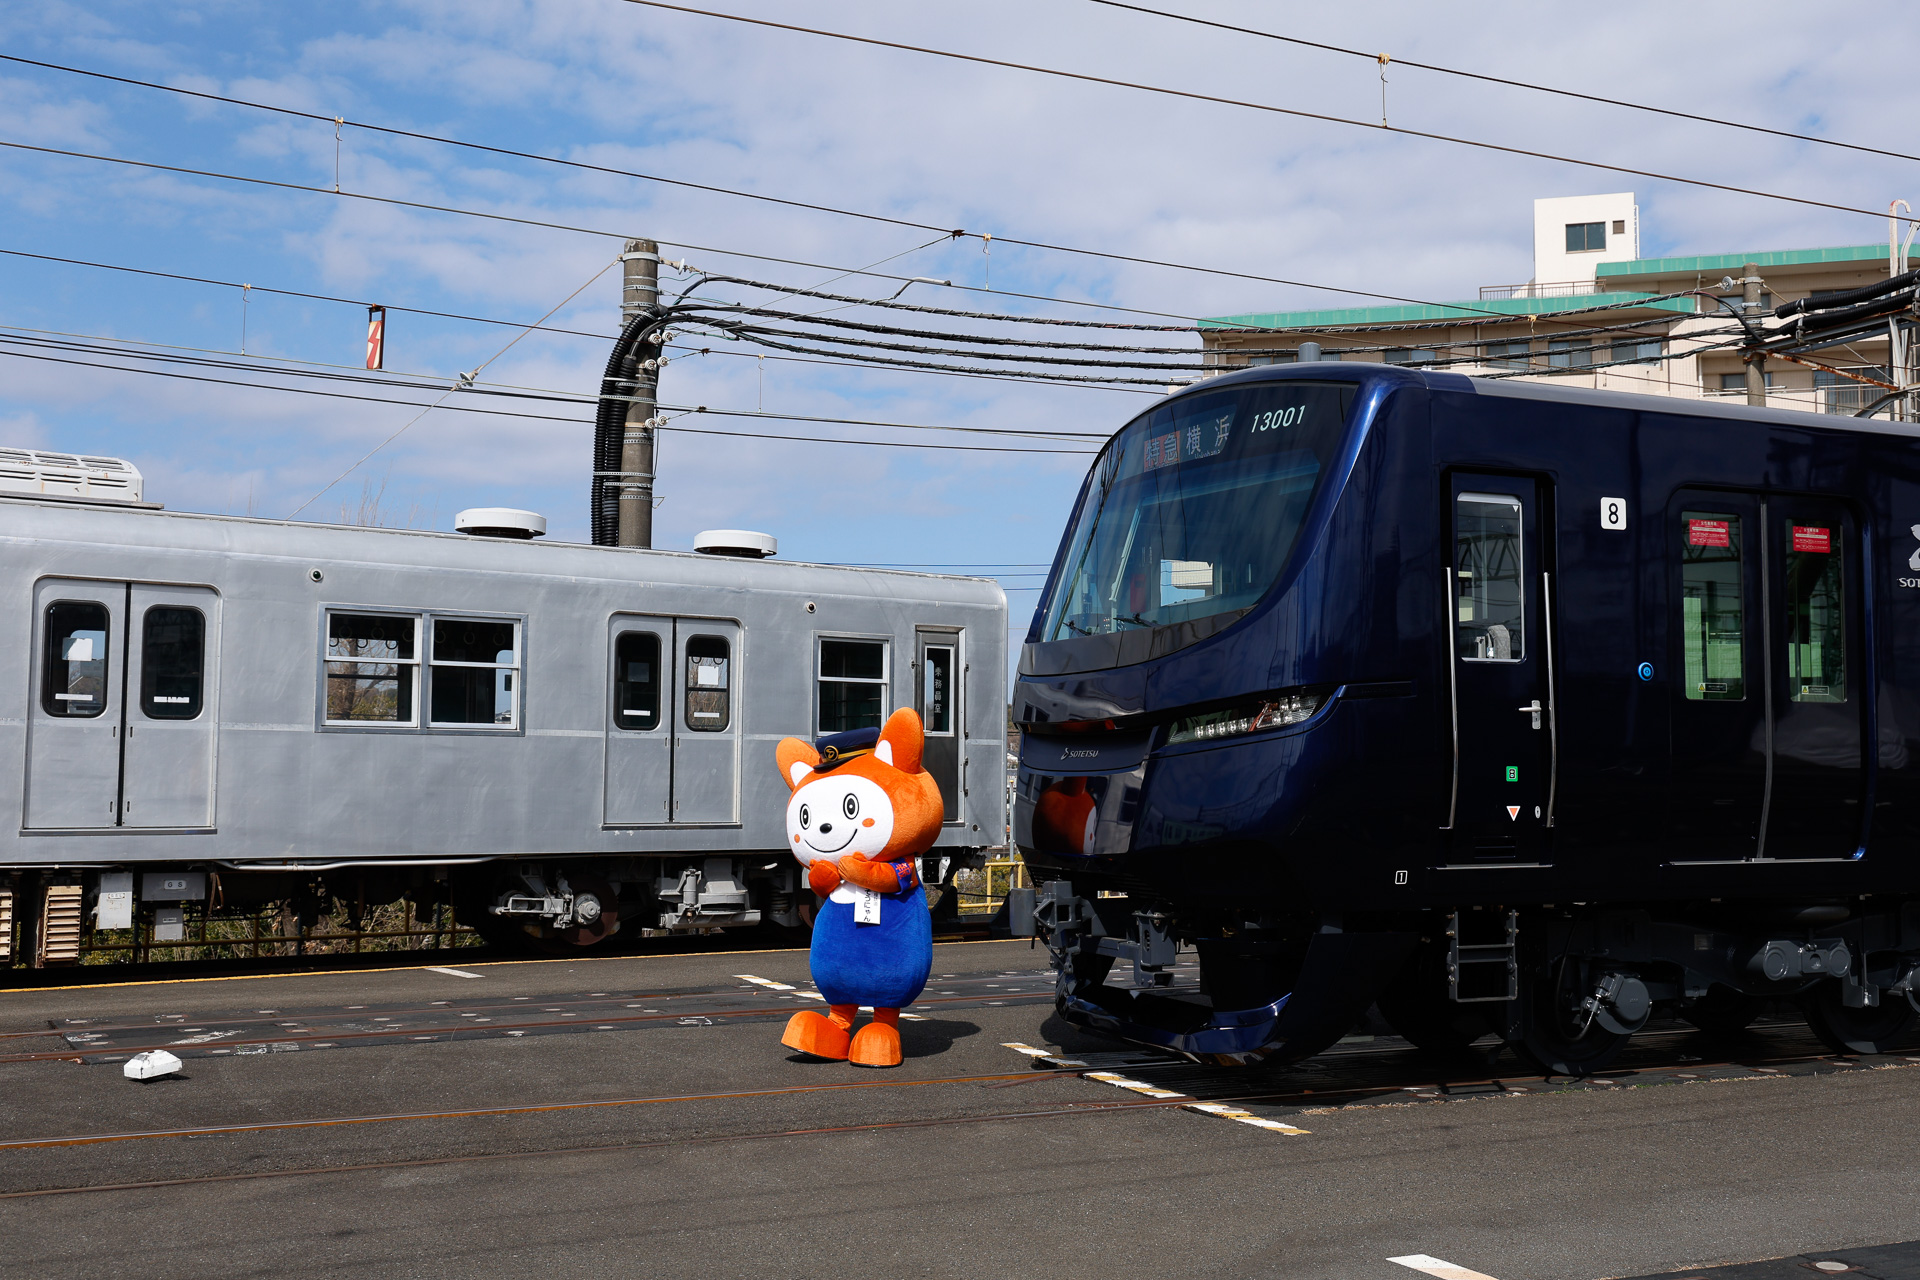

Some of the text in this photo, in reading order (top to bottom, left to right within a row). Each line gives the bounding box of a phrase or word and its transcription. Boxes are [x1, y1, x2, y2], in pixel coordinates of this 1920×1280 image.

[1252, 405, 1305, 433] 13001
[1146, 415, 1229, 467] 特急 横浜
[1609, 502, 1619, 524] 8
[1070, 750, 1099, 758] SOTETSU
